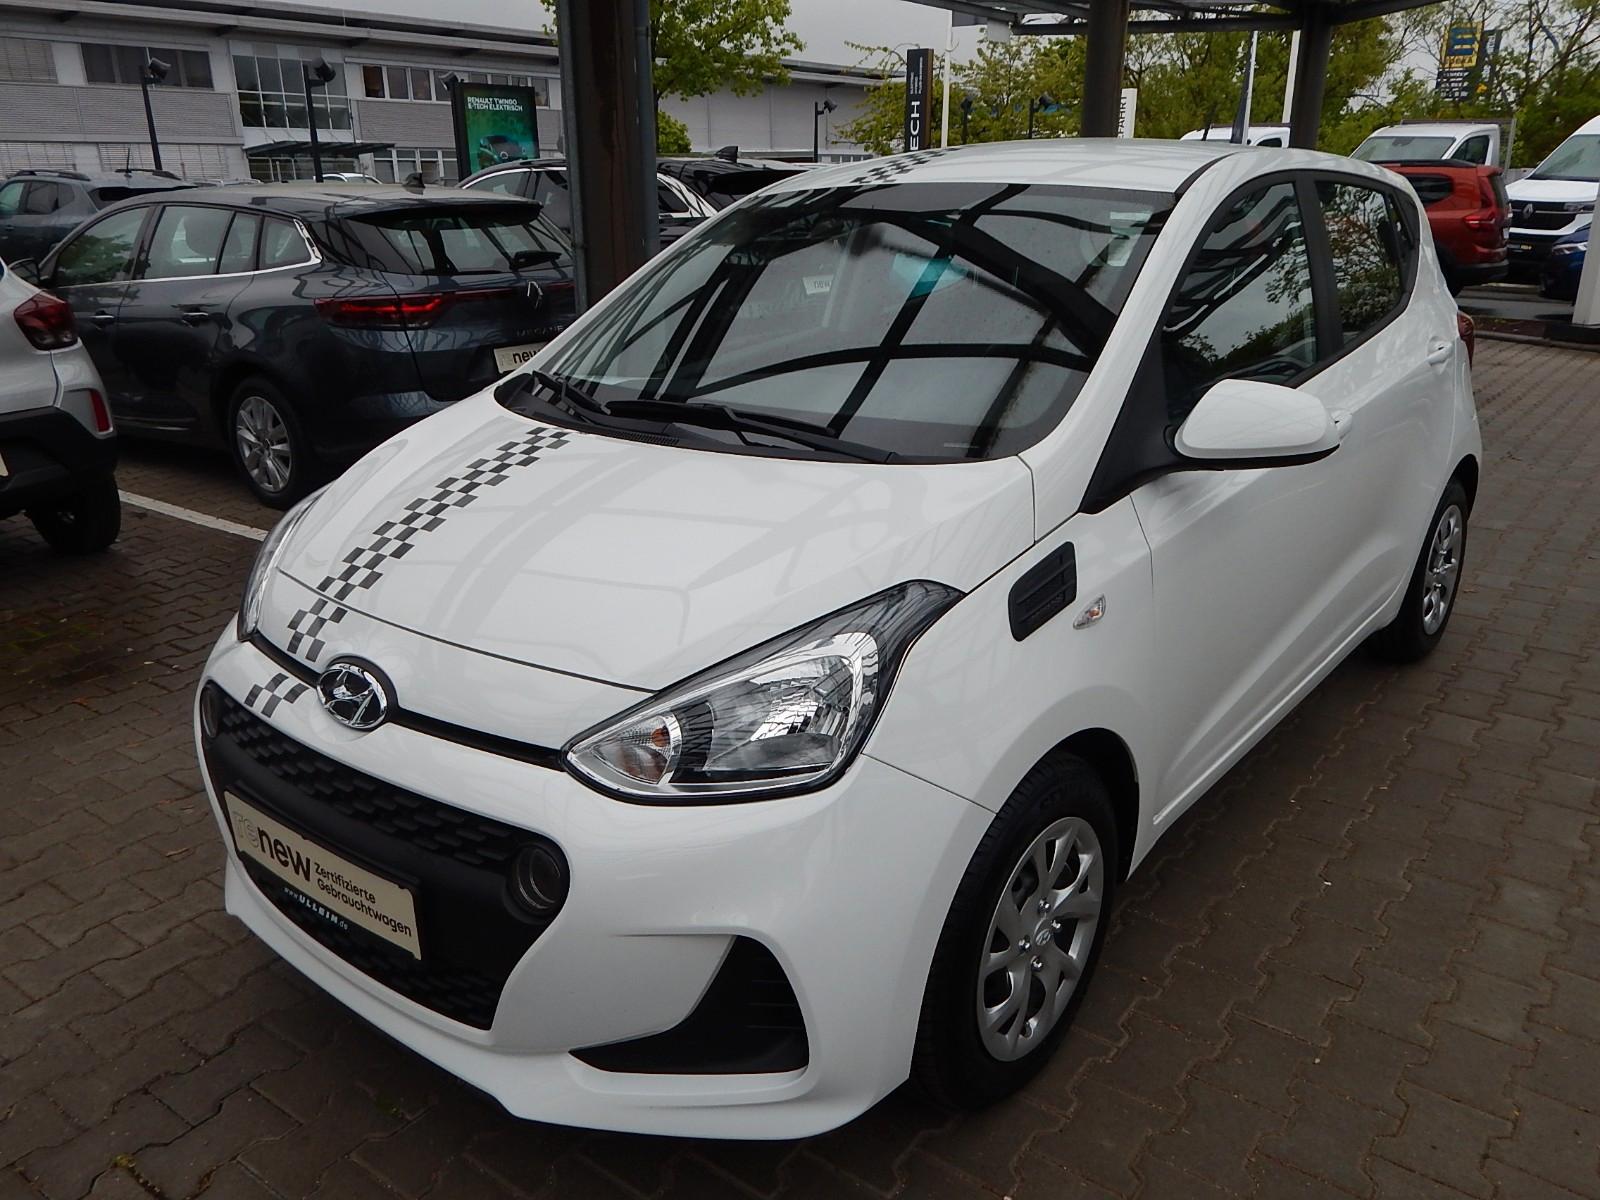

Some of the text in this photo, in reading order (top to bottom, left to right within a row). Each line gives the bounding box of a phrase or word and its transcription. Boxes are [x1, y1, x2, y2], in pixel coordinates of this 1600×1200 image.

[467, 96, 517, 105] RENAULT TWINGO
[489, 103, 523, 111] ELEKTRISCH
[314, 861, 376, 904] Zertifizierte
[317, 878, 412, 937] Gebrauchtwagen
